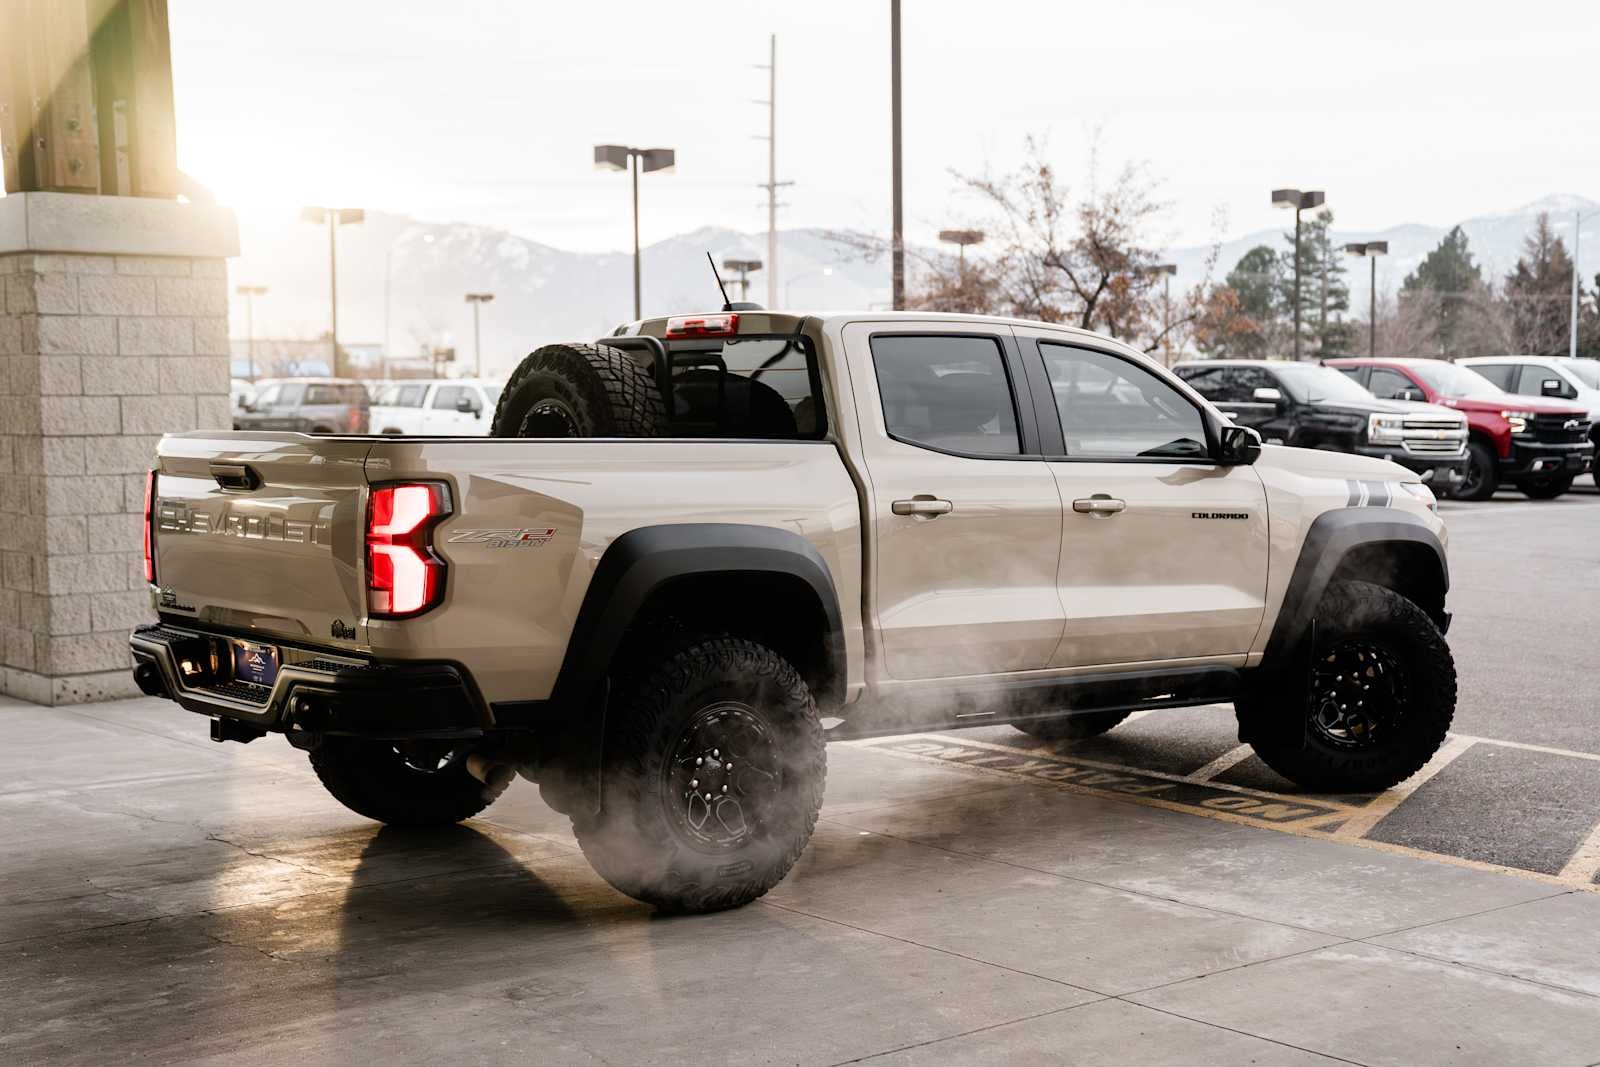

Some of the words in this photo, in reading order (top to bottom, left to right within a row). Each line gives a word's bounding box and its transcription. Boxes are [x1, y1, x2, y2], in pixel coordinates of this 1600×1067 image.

[160, 506, 327, 545] CHEVROLET
[448, 527, 556, 543] ZR2
[891, 743, 1178, 793] PARKING
[1200, 796, 1314, 819] NO
